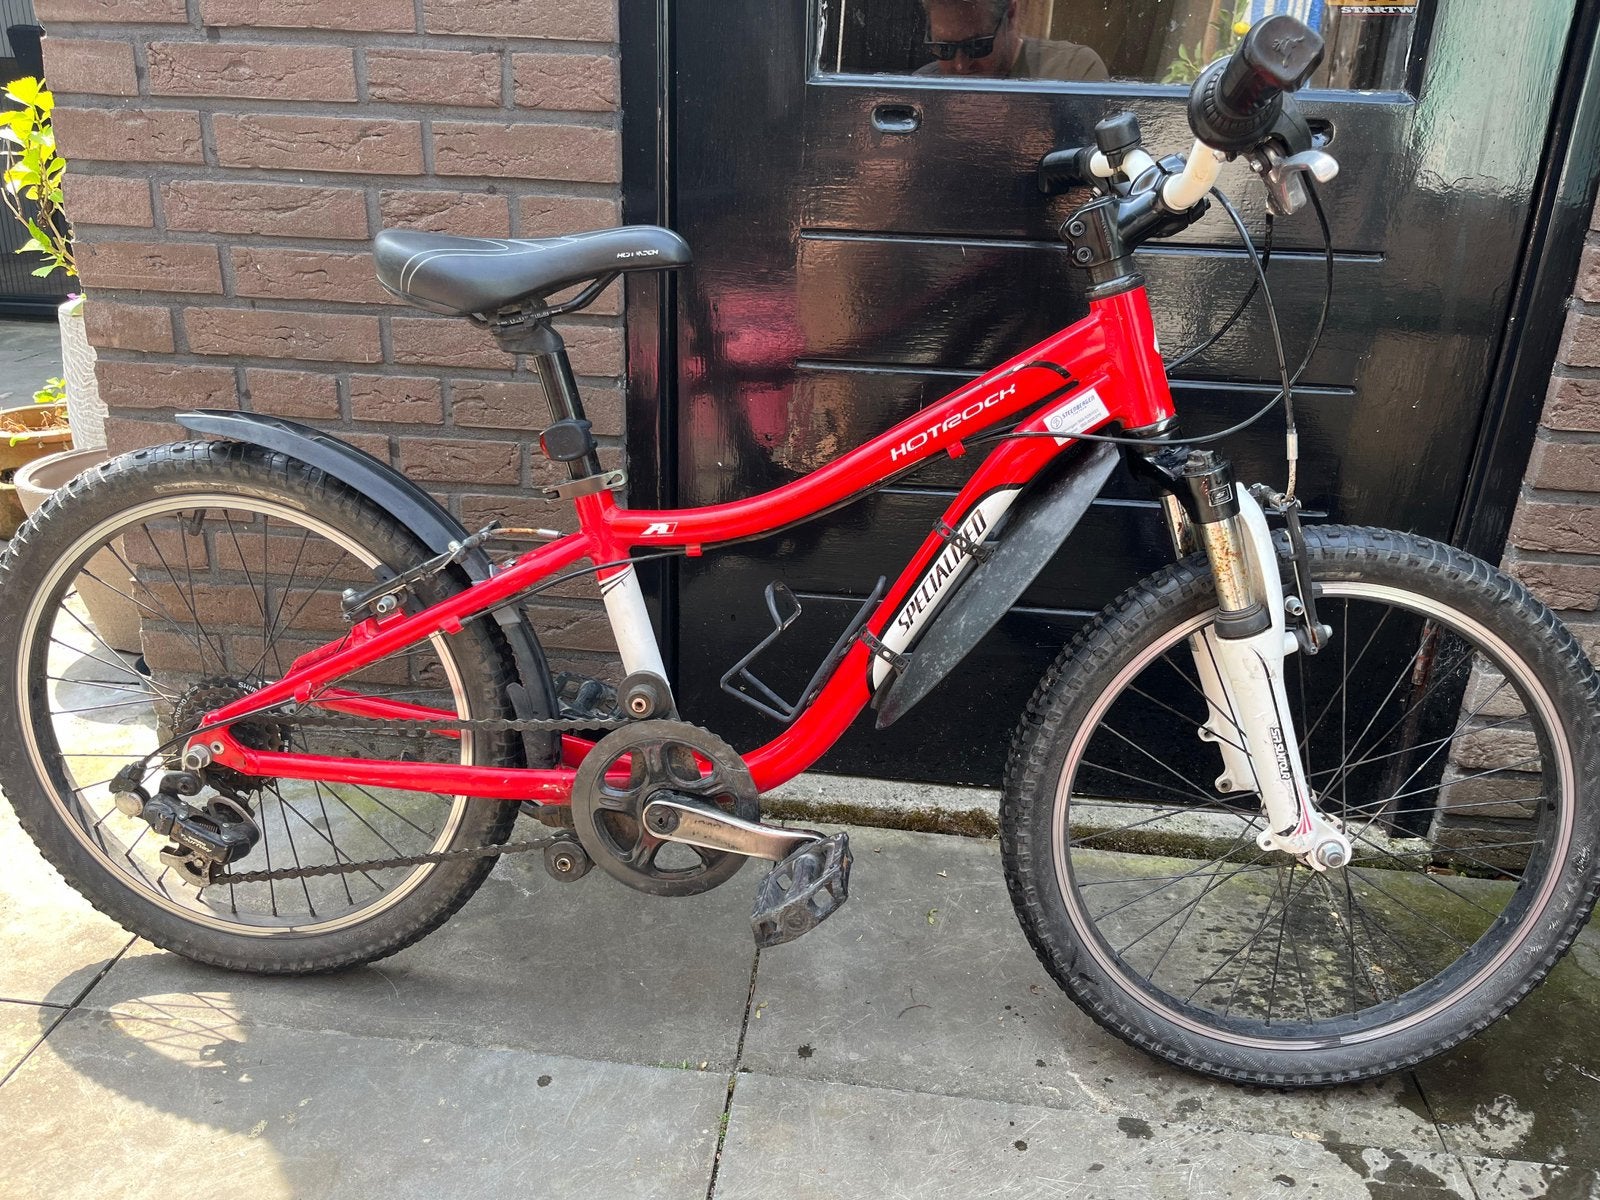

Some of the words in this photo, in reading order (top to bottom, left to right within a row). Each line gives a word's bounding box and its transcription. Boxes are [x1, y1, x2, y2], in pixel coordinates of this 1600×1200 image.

[1340, 6, 1416, 14] STARTW
[890, 383, 1016, 462] HOTROCK
[238, 681, 259, 693] SHIM
